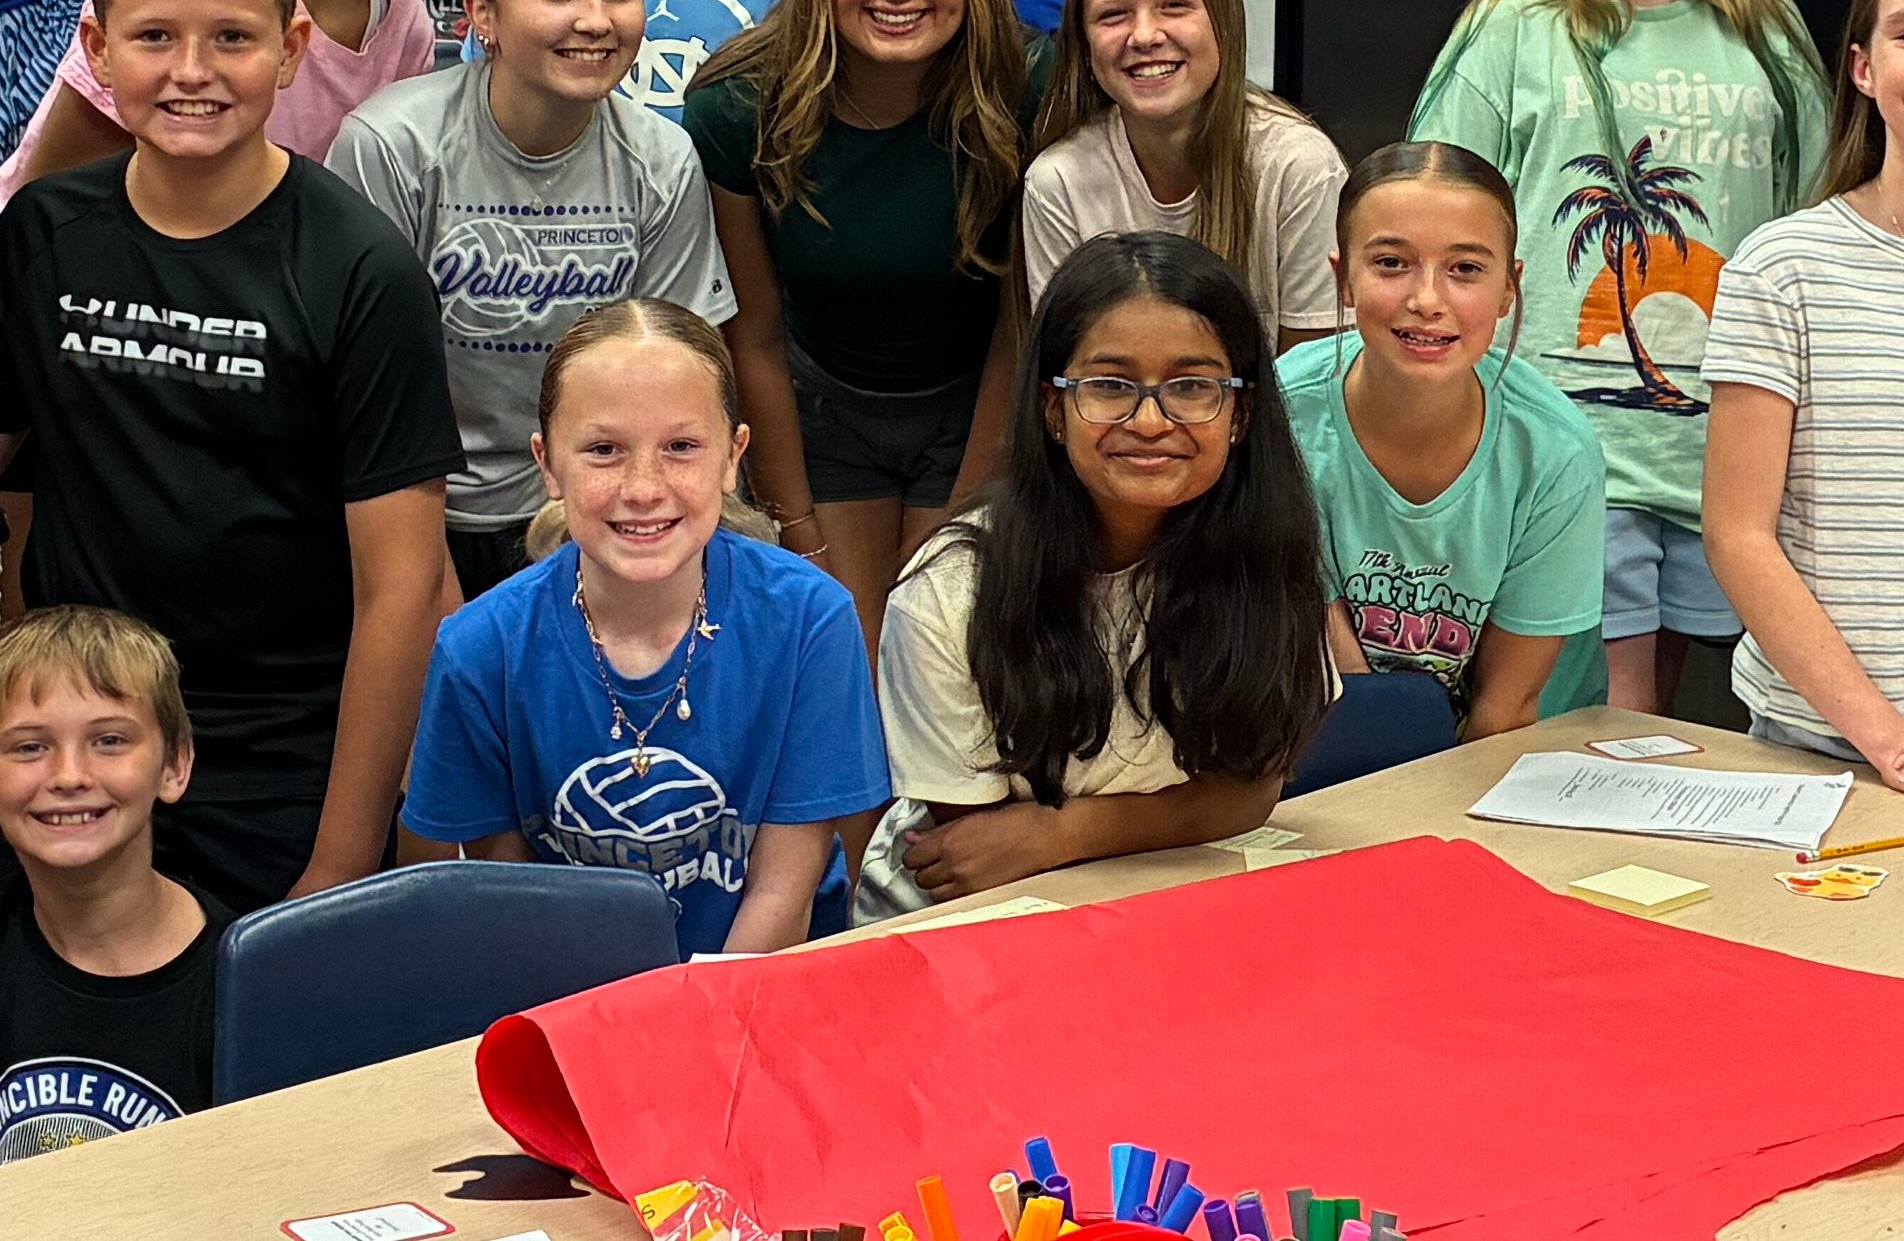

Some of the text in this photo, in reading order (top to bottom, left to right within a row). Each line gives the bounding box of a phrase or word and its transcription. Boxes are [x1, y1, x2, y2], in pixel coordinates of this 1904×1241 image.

[1561, 68, 1767, 120] positive
[433, 251, 635, 313] Volleyball
[103, 300, 267, 340] UNDER
[59, 331, 266, 379] ARMOUR
[1359, 550, 1452, 580] 17th Annual
[1345, 572, 1492, 627] ARTLAN
[1358, 604, 1472, 660] END
[103, 1082, 168, 1128] RUN
